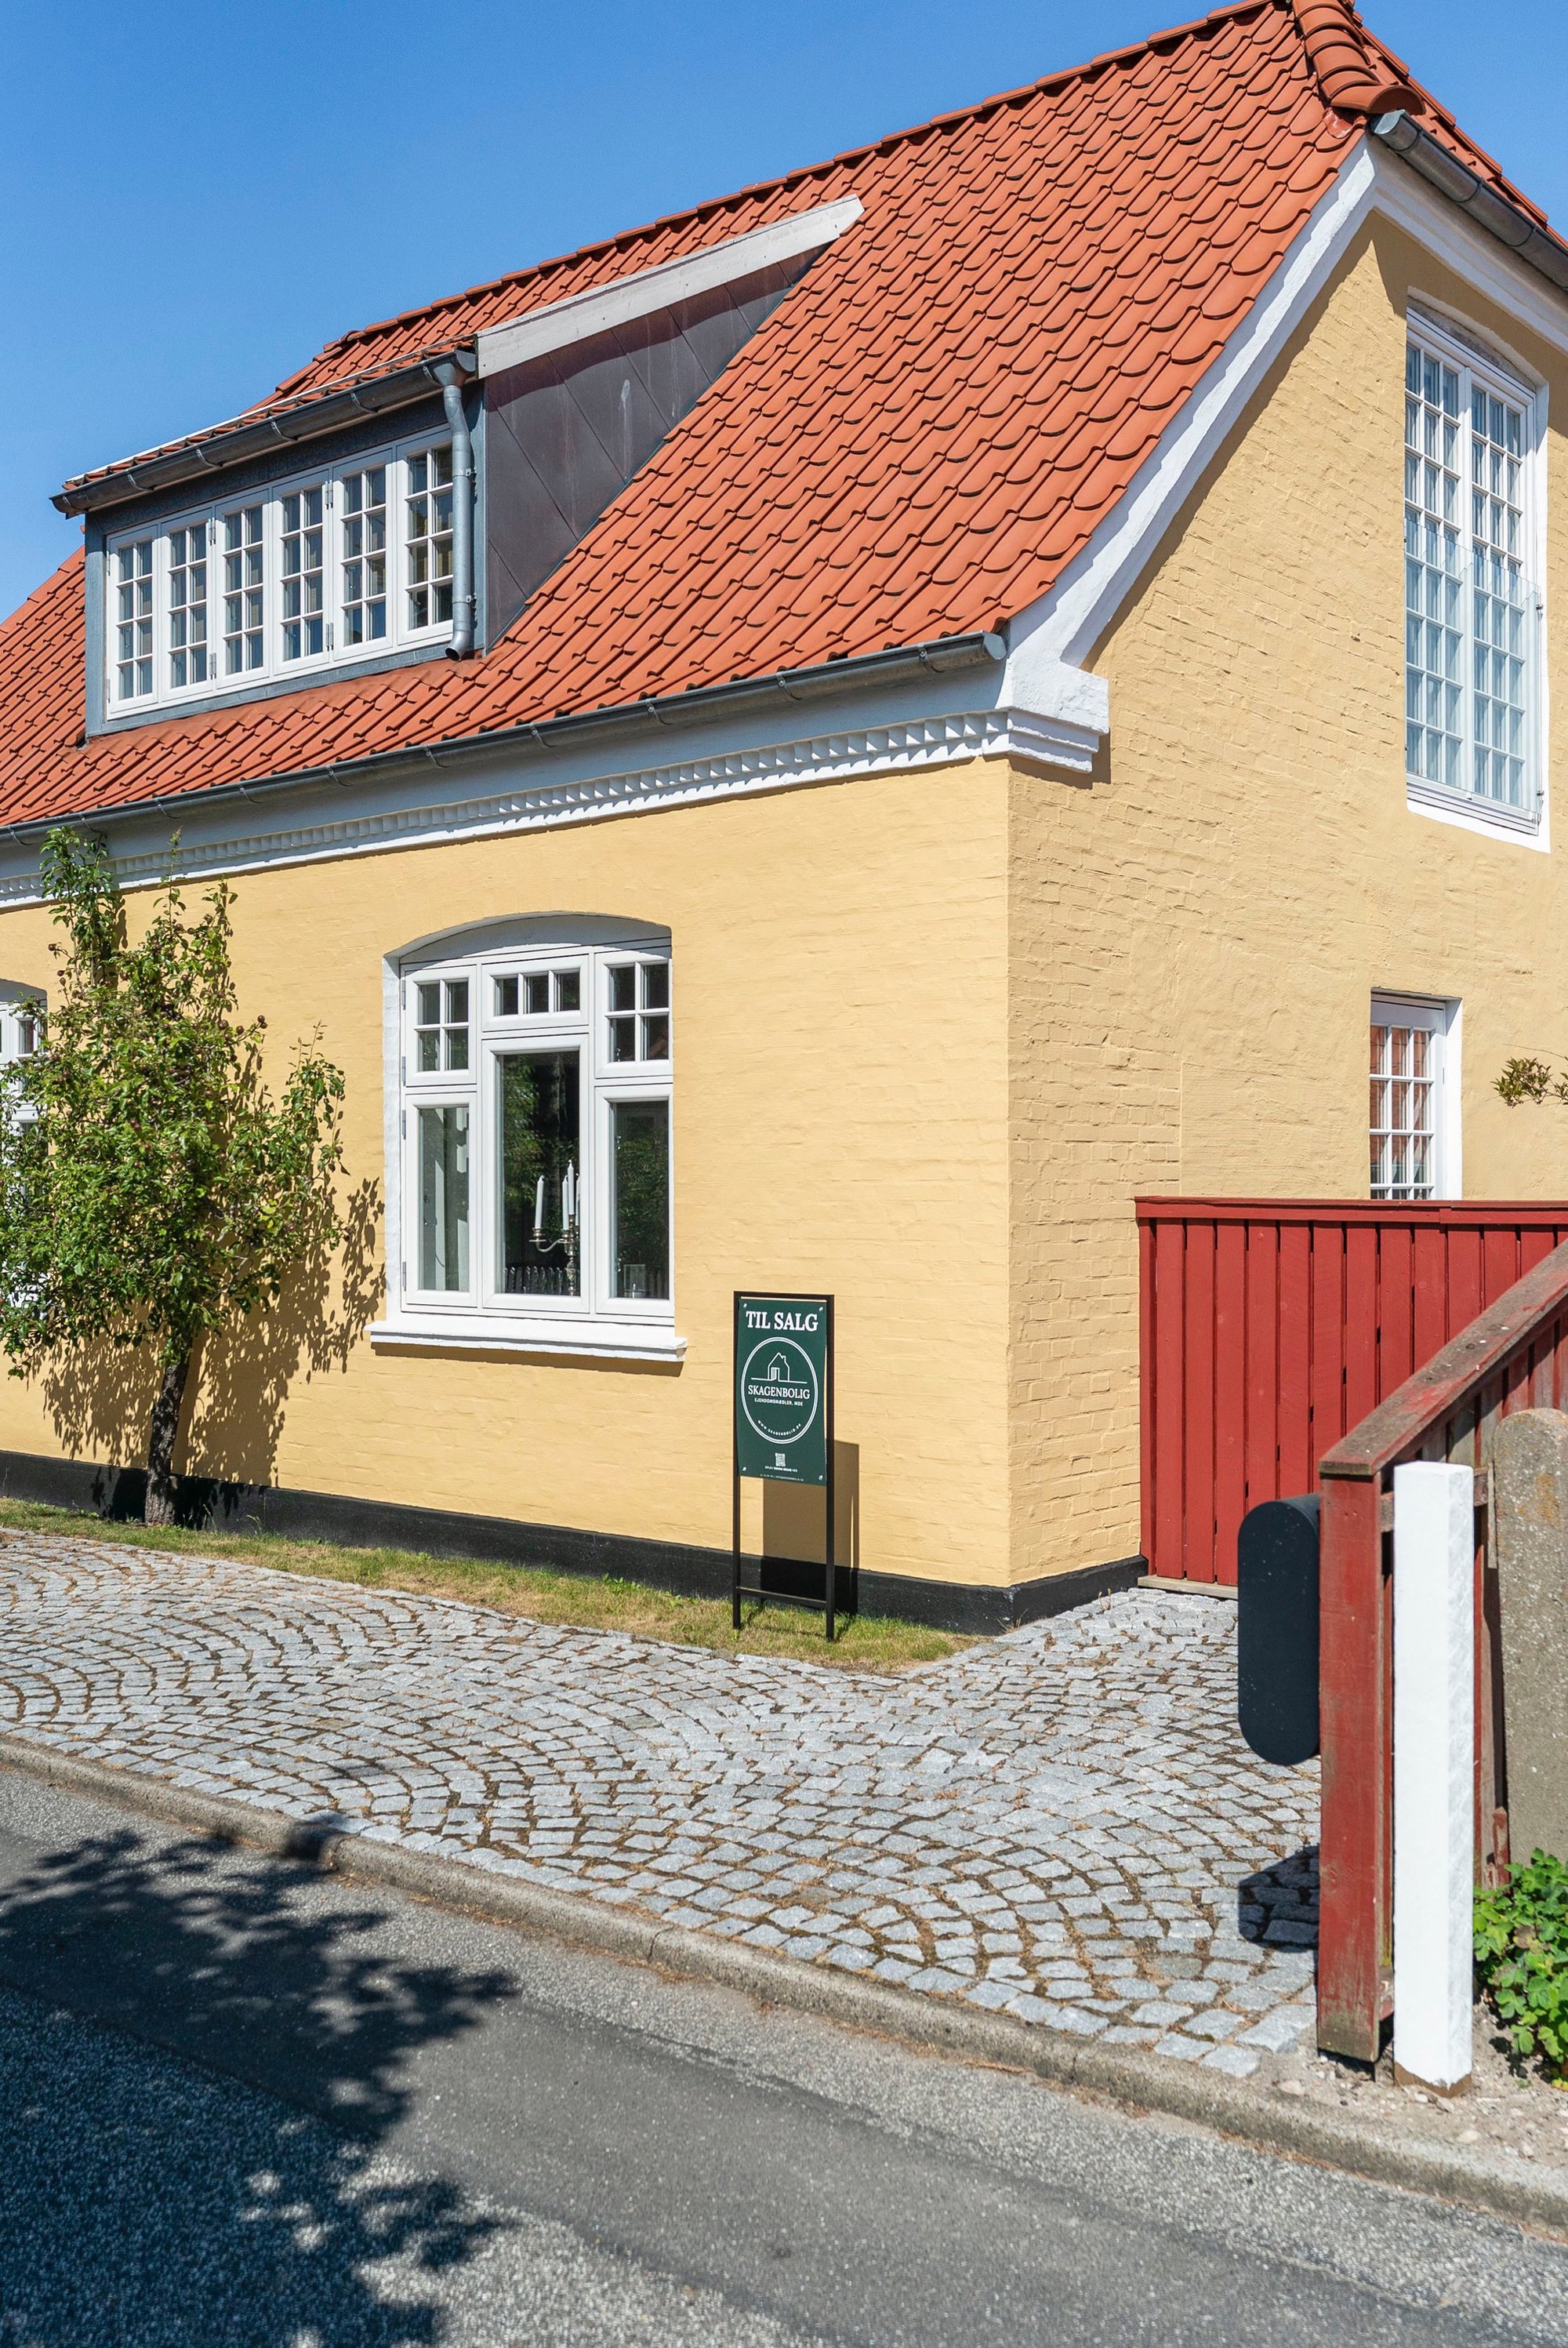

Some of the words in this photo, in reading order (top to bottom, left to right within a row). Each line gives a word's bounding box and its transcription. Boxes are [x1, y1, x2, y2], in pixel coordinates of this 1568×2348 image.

[746, 1310, 771, 1329] TIL
[774, 1311, 818, 1332] SALG
[748, 1384, 811, 1400] SKAGENBOLIG
